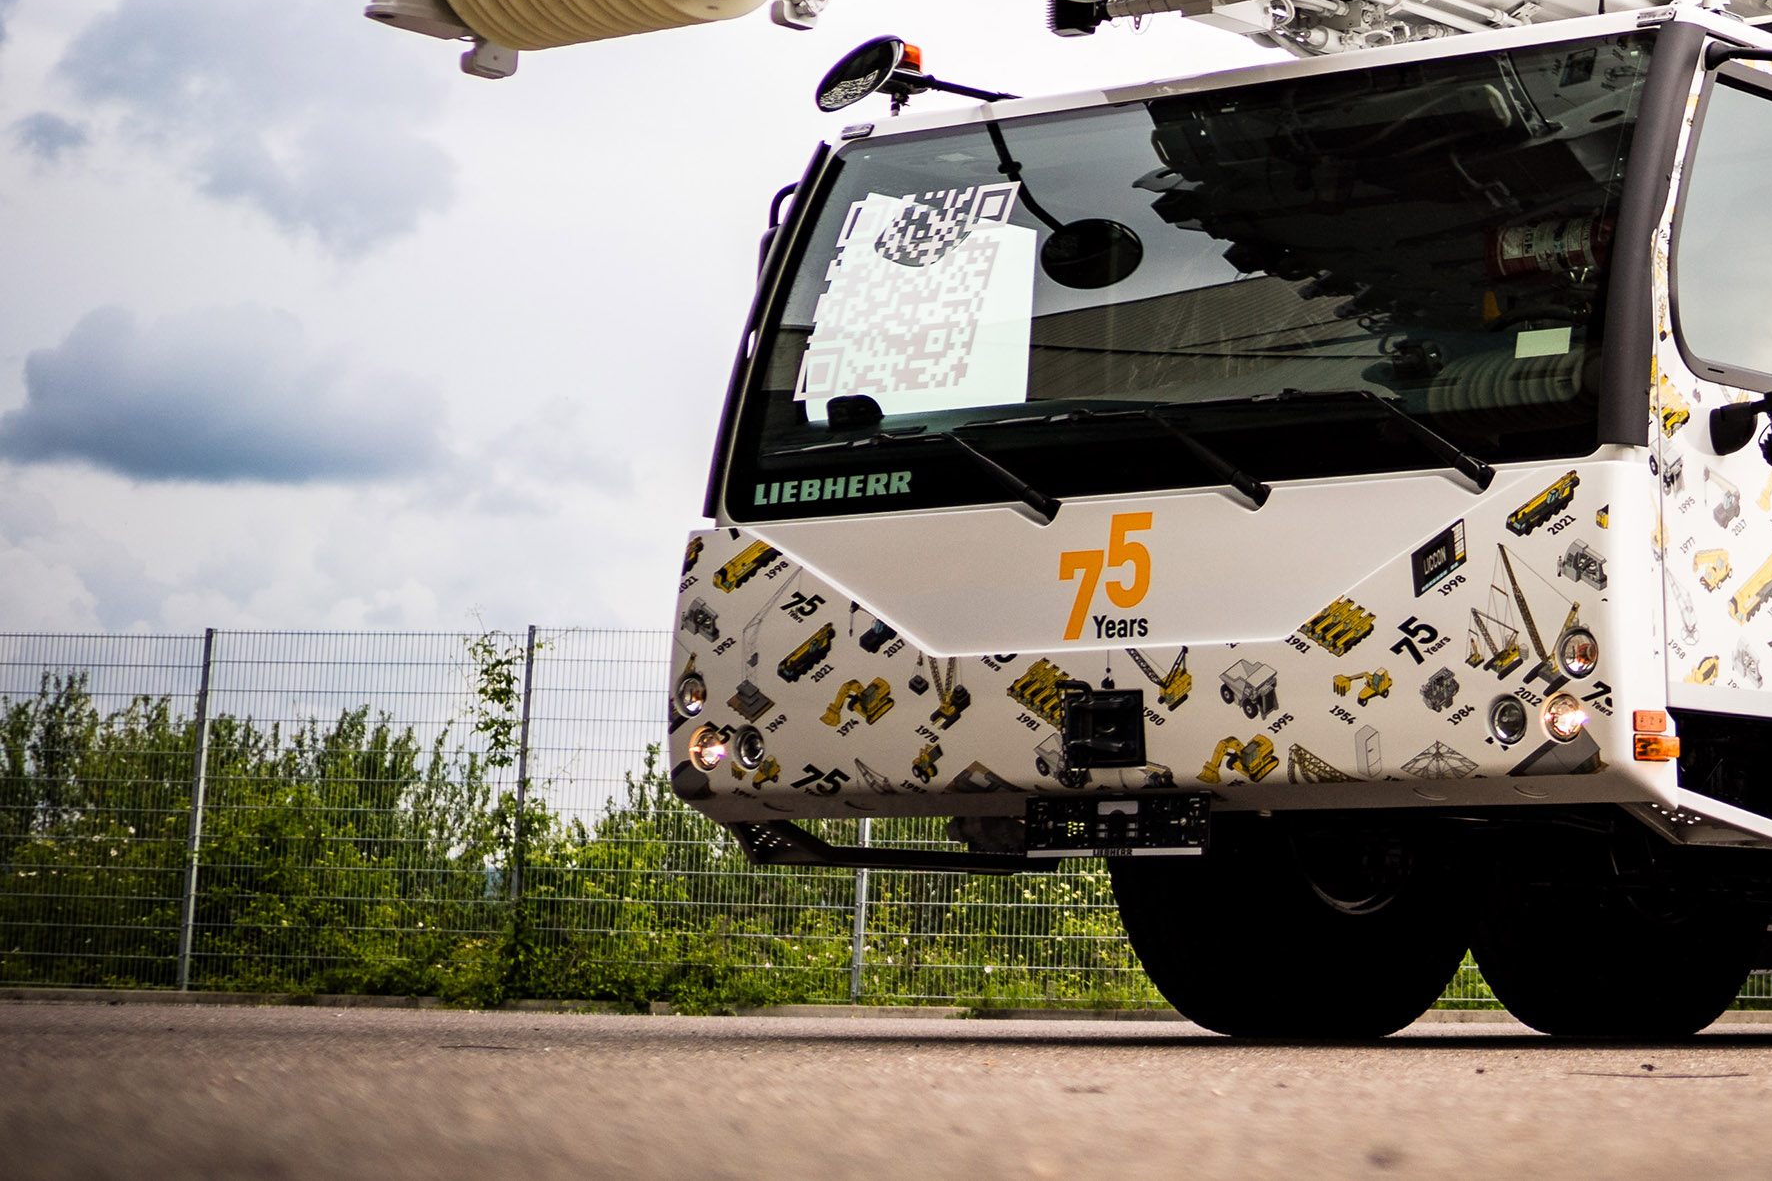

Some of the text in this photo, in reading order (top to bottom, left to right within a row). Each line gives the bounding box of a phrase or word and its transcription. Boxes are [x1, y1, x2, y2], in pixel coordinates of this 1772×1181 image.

[754, 471, 912, 506] LIEBHERR
[1678, 496, 1696, 515] 1995
[1547, 514, 1576, 536] 2021
[1731, 518, 1748, 537] 2017
[764, 560, 789, 580] 1998
[1058, 511, 1153, 641] 75
[1437, 575, 1466, 597] 1998
[780, 591, 826, 616] 75
[1093, 615, 1148, 639] Years
[713, 637, 736, 657] 1952
[883, 639, 906, 658] 2017
[1284, 634, 1312, 654] 1981
[1389, 616, 1439, 665] 75
[1423, 635, 1451, 656] Years
[1667, 638, 1686, 660] 1958
[811, 664, 835, 683] 2021
[1514, 687, 1542, 707] 2012
[1329, 705, 1357, 726] 1954
[1446, 704, 1476, 726] 1984
[1591, 700, 1614, 716] Years
[765, 714, 788, 733] 1949
[836, 718, 859, 737] 1974
[1016, 712, 1040, 732] 1981
[1267, 713, 1295, 735] 1995
[915, 725, 939, 744] 1978
[790, 763, 850, 795] 75
